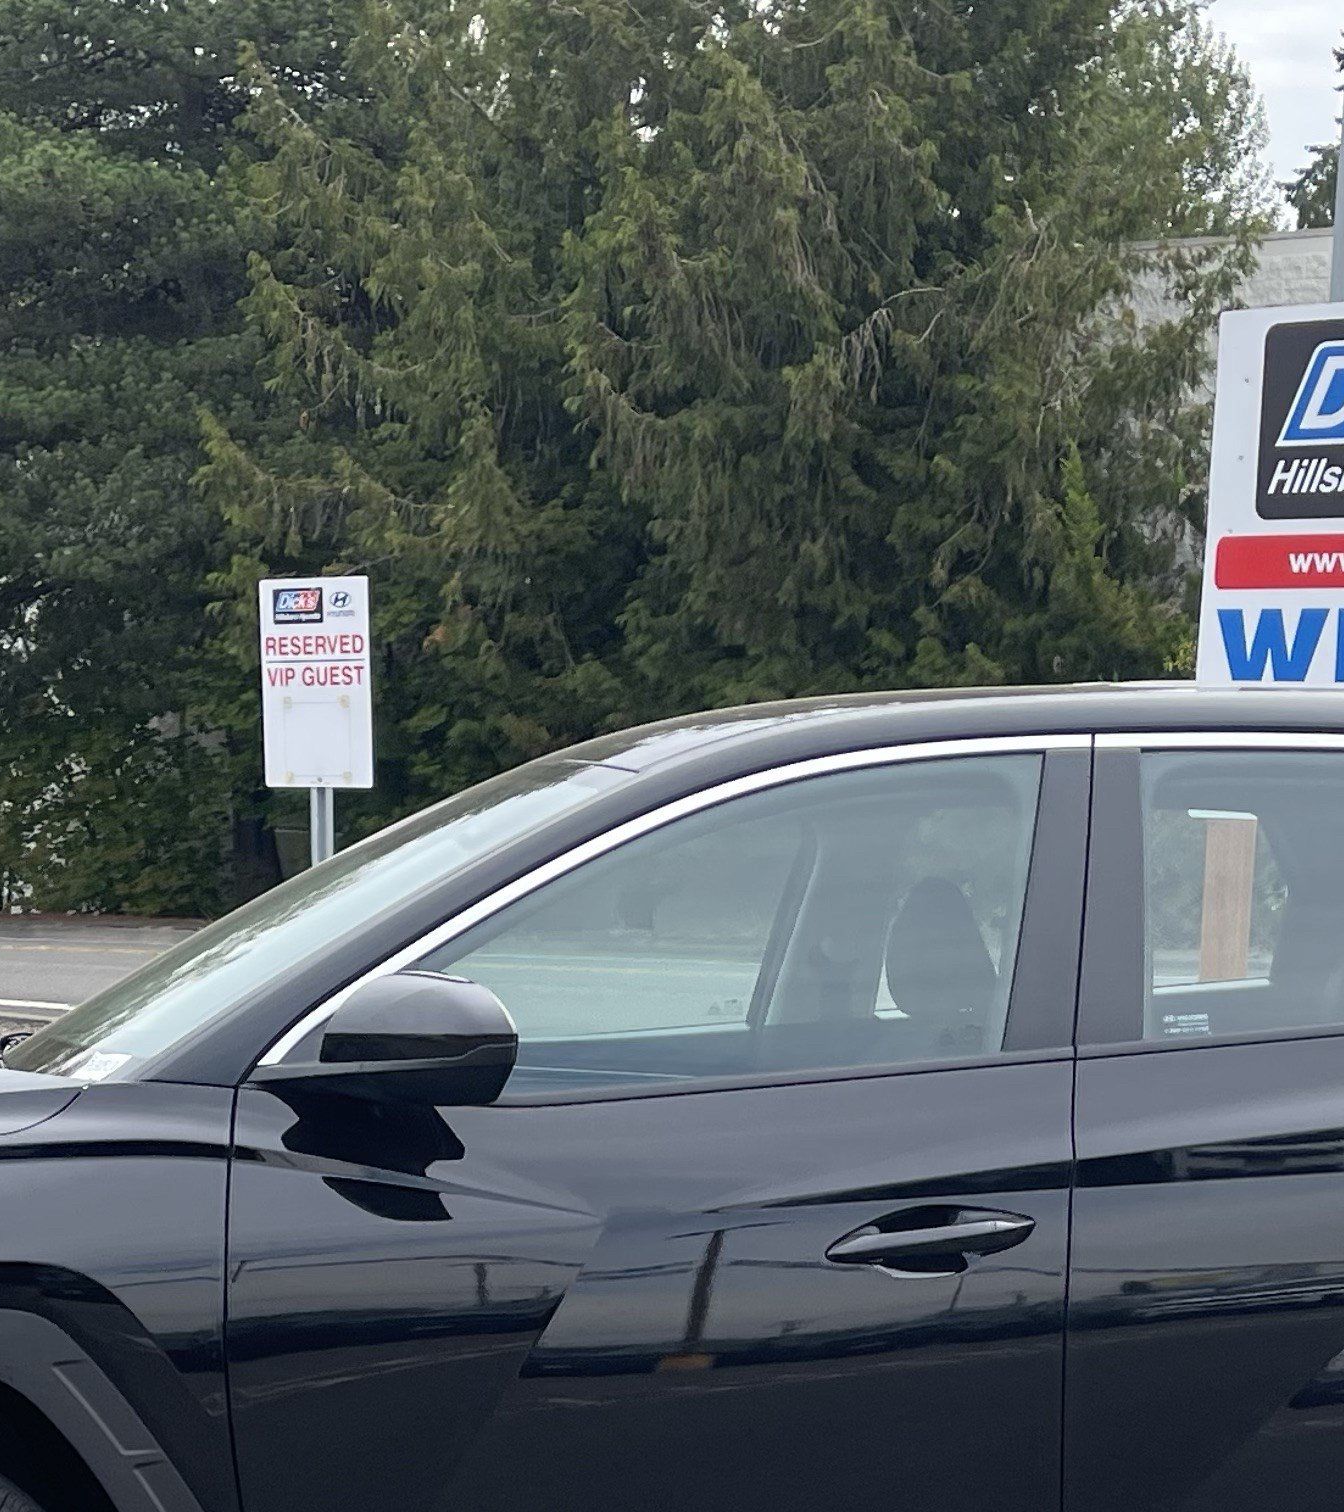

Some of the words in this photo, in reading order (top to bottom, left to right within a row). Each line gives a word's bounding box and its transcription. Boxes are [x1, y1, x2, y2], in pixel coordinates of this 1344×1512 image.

[265, 634, 365, 657] RESERVED
[267, 667, 296, 687] VIP
[302, 665, 365, 687] GUEST
